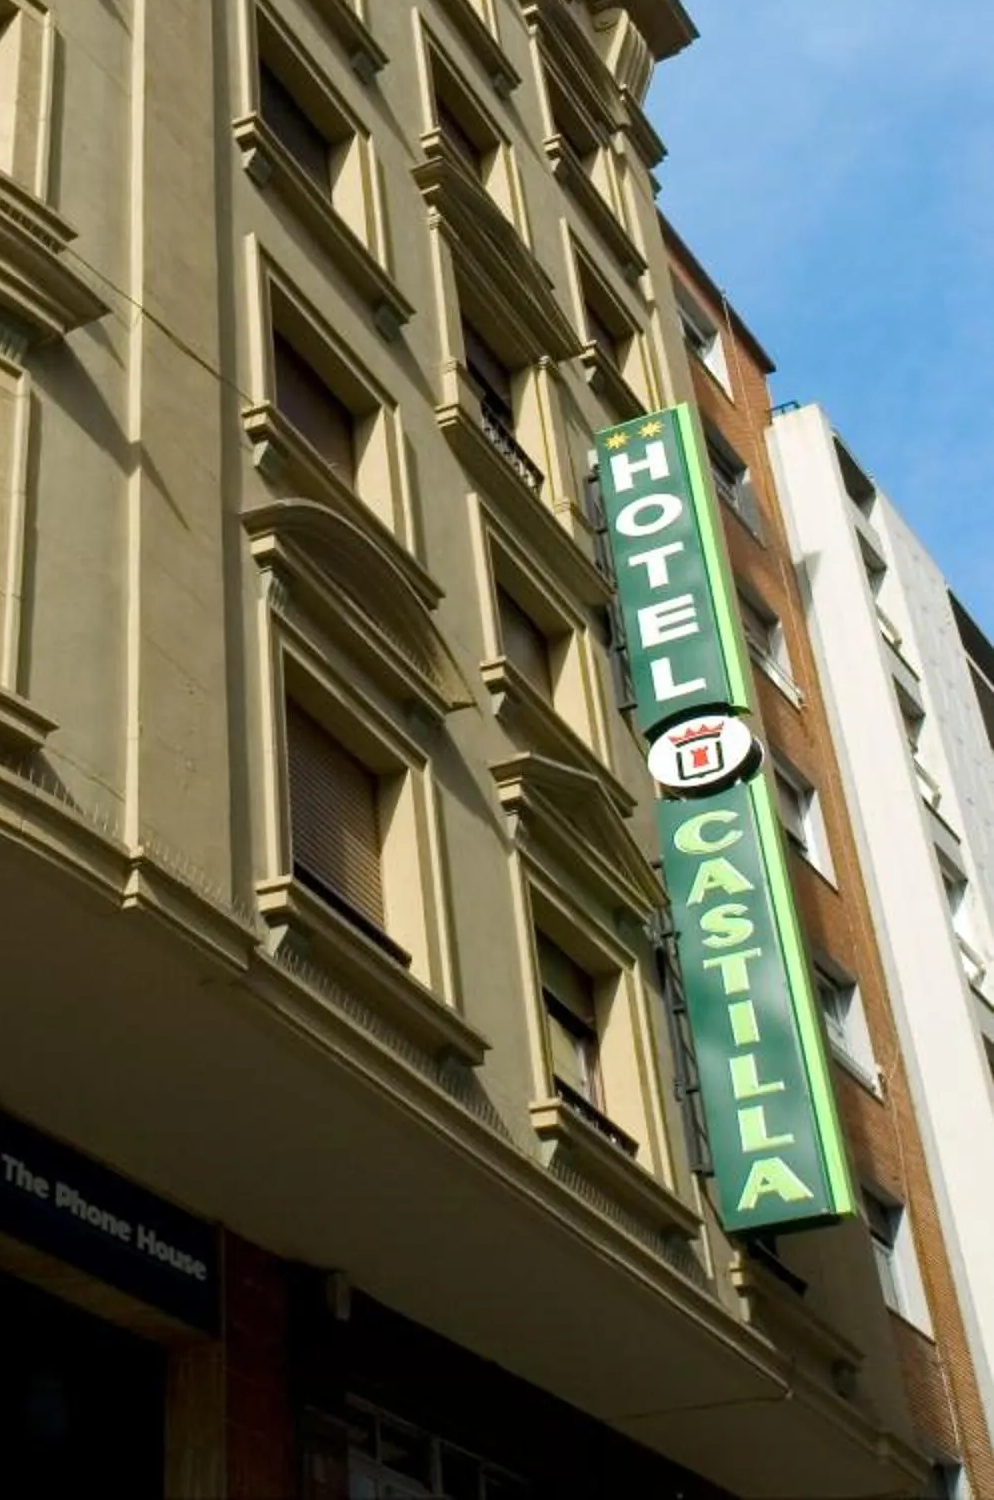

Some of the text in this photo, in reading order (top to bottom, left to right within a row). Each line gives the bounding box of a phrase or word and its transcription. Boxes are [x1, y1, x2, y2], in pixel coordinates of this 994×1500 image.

[610, 440, 707, 701] HOTEL
[674, 809, 814, 1212] CASTILLA
[0, 1152, 208, 1282] The Phone House
